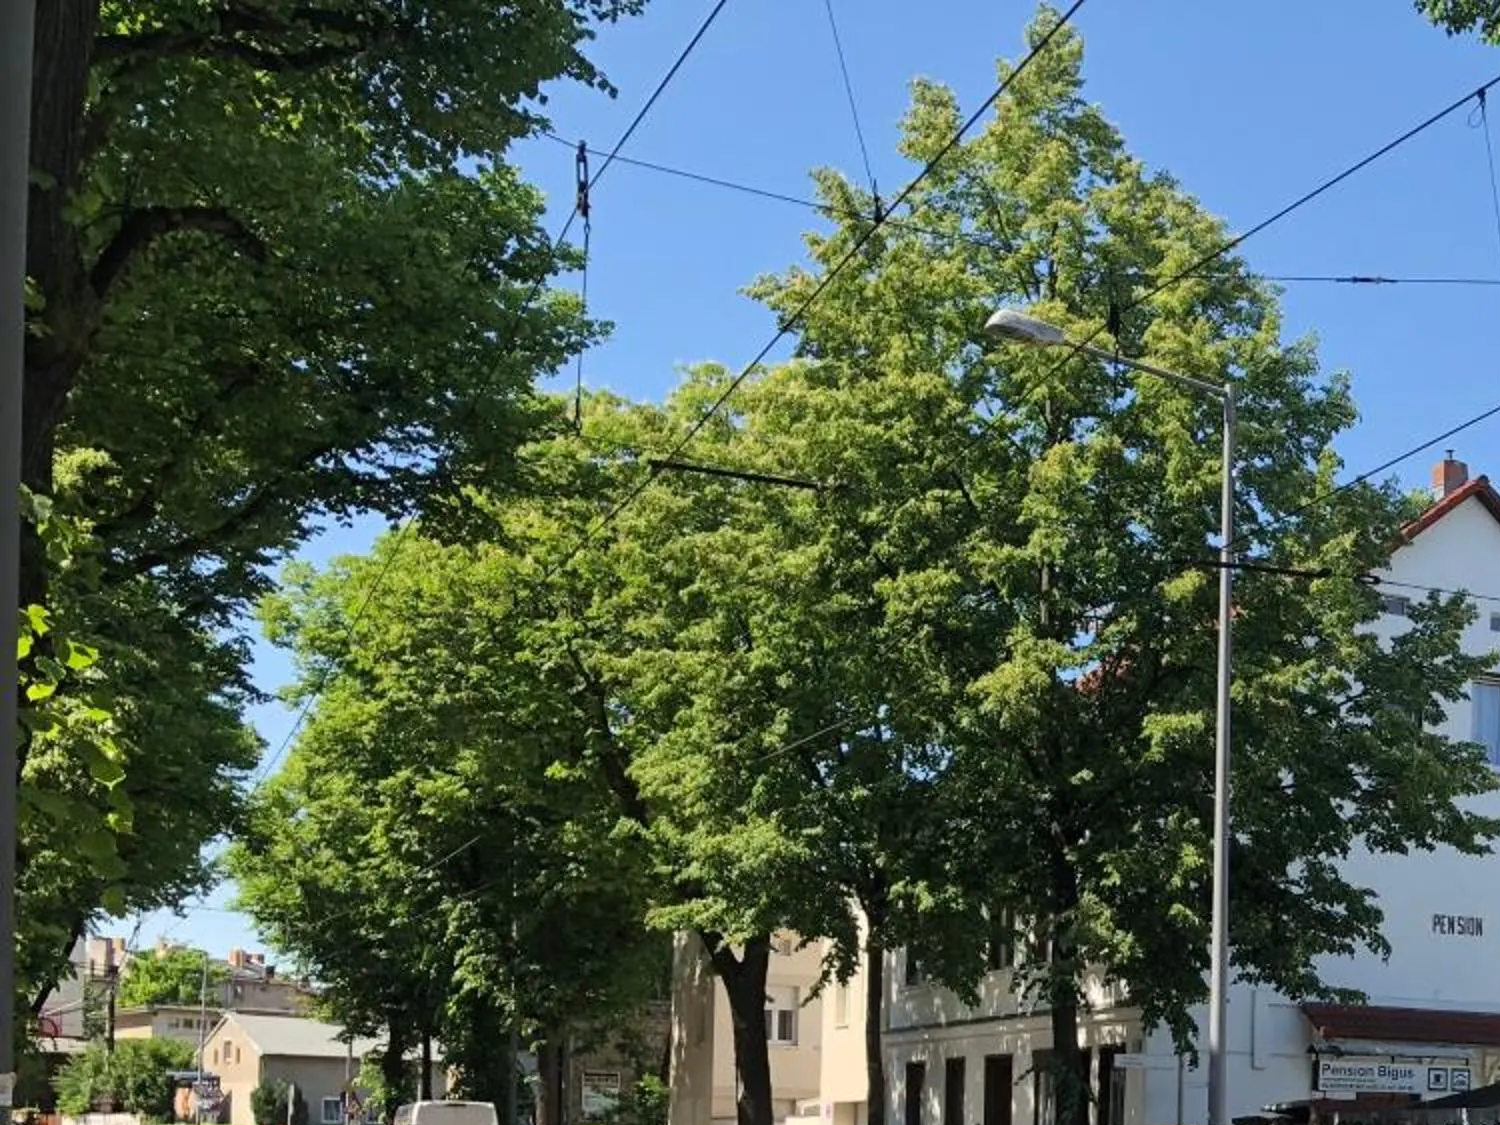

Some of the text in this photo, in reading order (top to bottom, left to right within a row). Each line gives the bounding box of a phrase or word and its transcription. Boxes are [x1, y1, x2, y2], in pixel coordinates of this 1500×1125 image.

[1432, 914, 1483, 936] PENSION
[1321, 1063, 1374, 1077] Pension
[1377, 1065, 1415, 1080] Bigus
